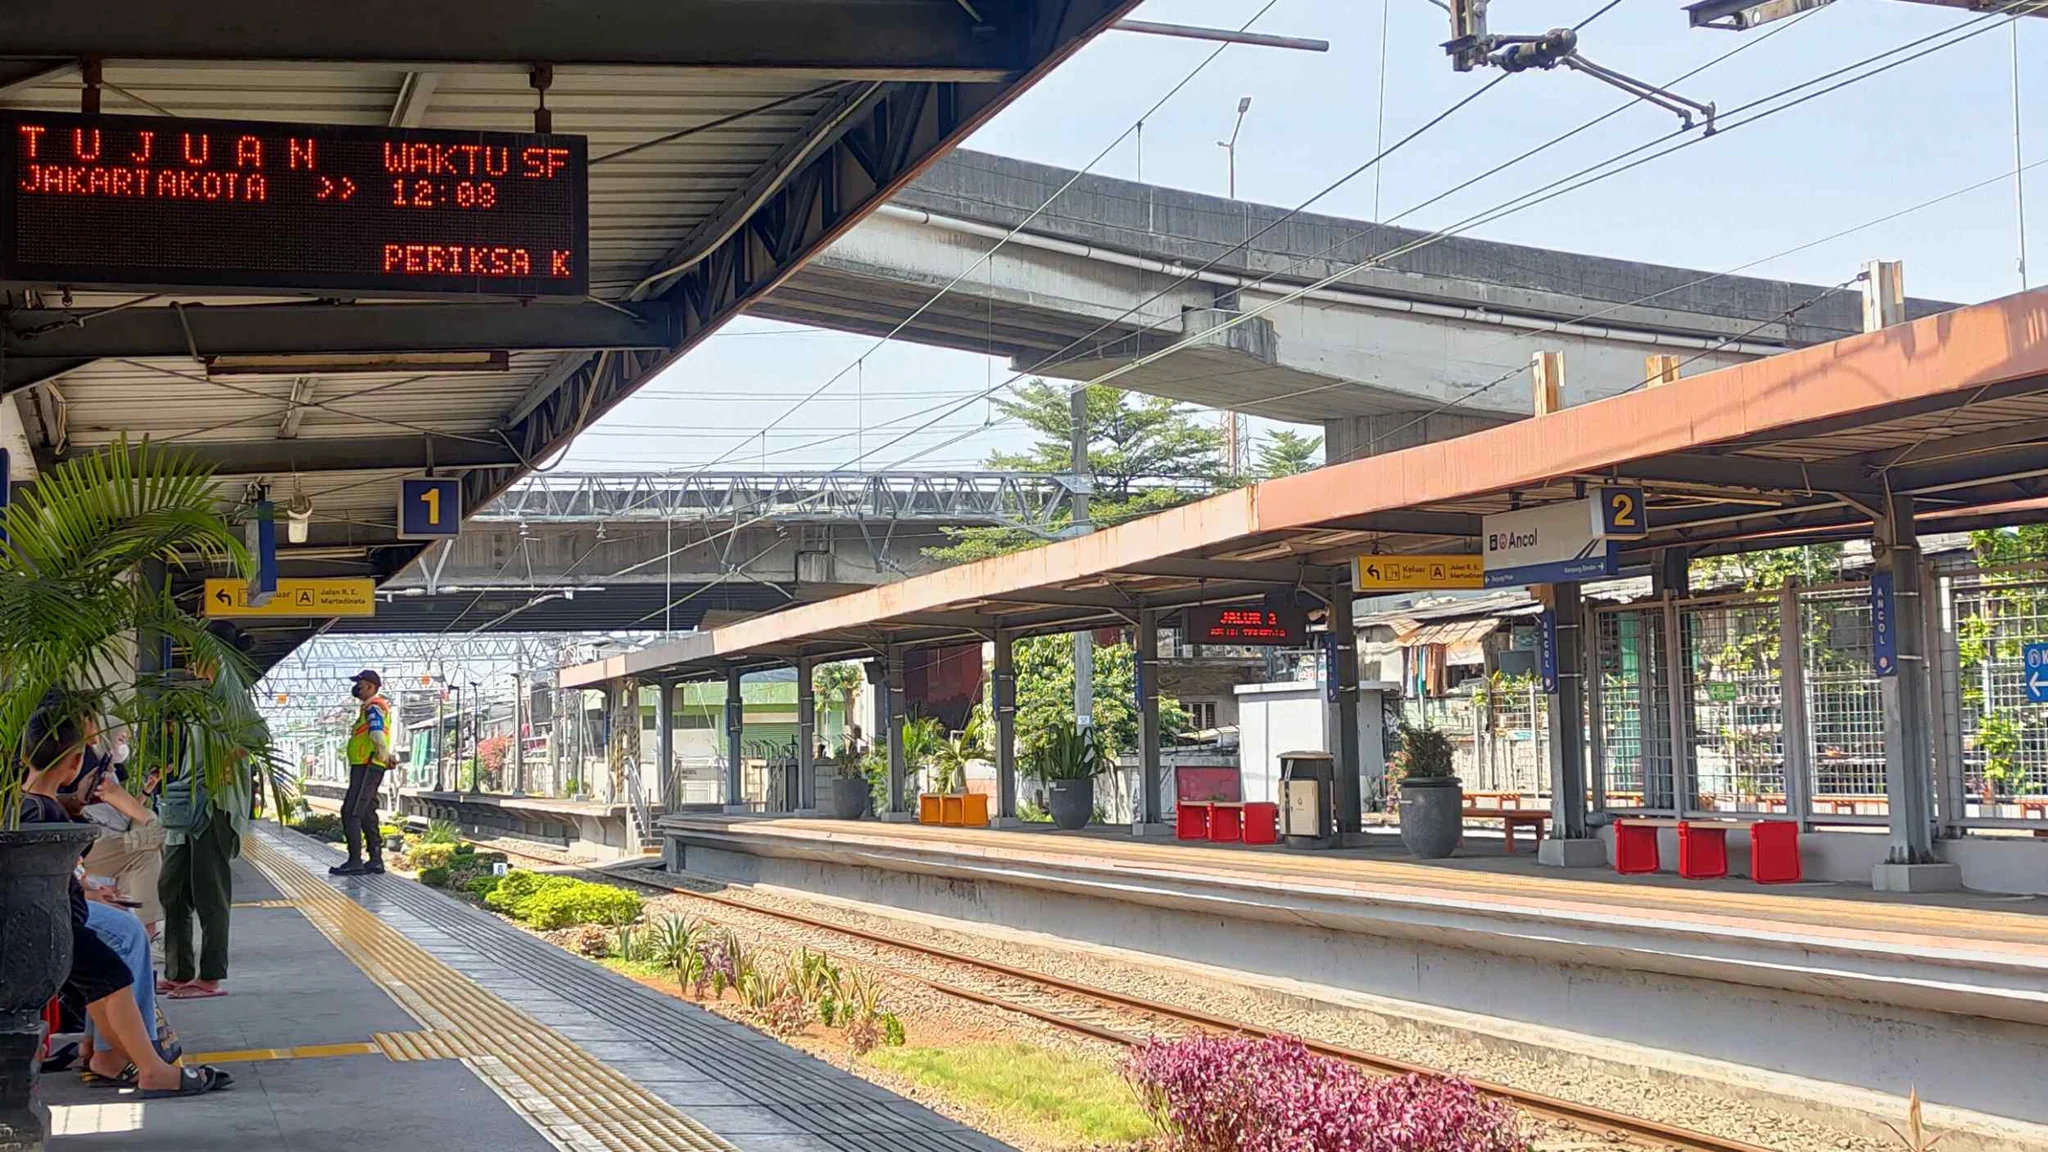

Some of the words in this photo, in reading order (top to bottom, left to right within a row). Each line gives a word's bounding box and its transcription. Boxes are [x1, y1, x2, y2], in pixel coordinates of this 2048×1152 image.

[384, 141, 510, 176] WAKTU
[522, 147, 571, 178] SF
[21, 164, 266, 201] JAKARTAKOTA
[392, 178, 496, 209] 12:08
[384, 244, 530, 275] PERIKSA
[552, 249, 572, 275] K
[420, 487, 440, 525] 1
[1611, 494, 1636, 527] 2
[1508, 528, 1538, 550] Ancol
[1433, 566, 1443, 578] A
[299, 590, 311, 604] A
[1876, 587, 1886, 645] ANCOL
